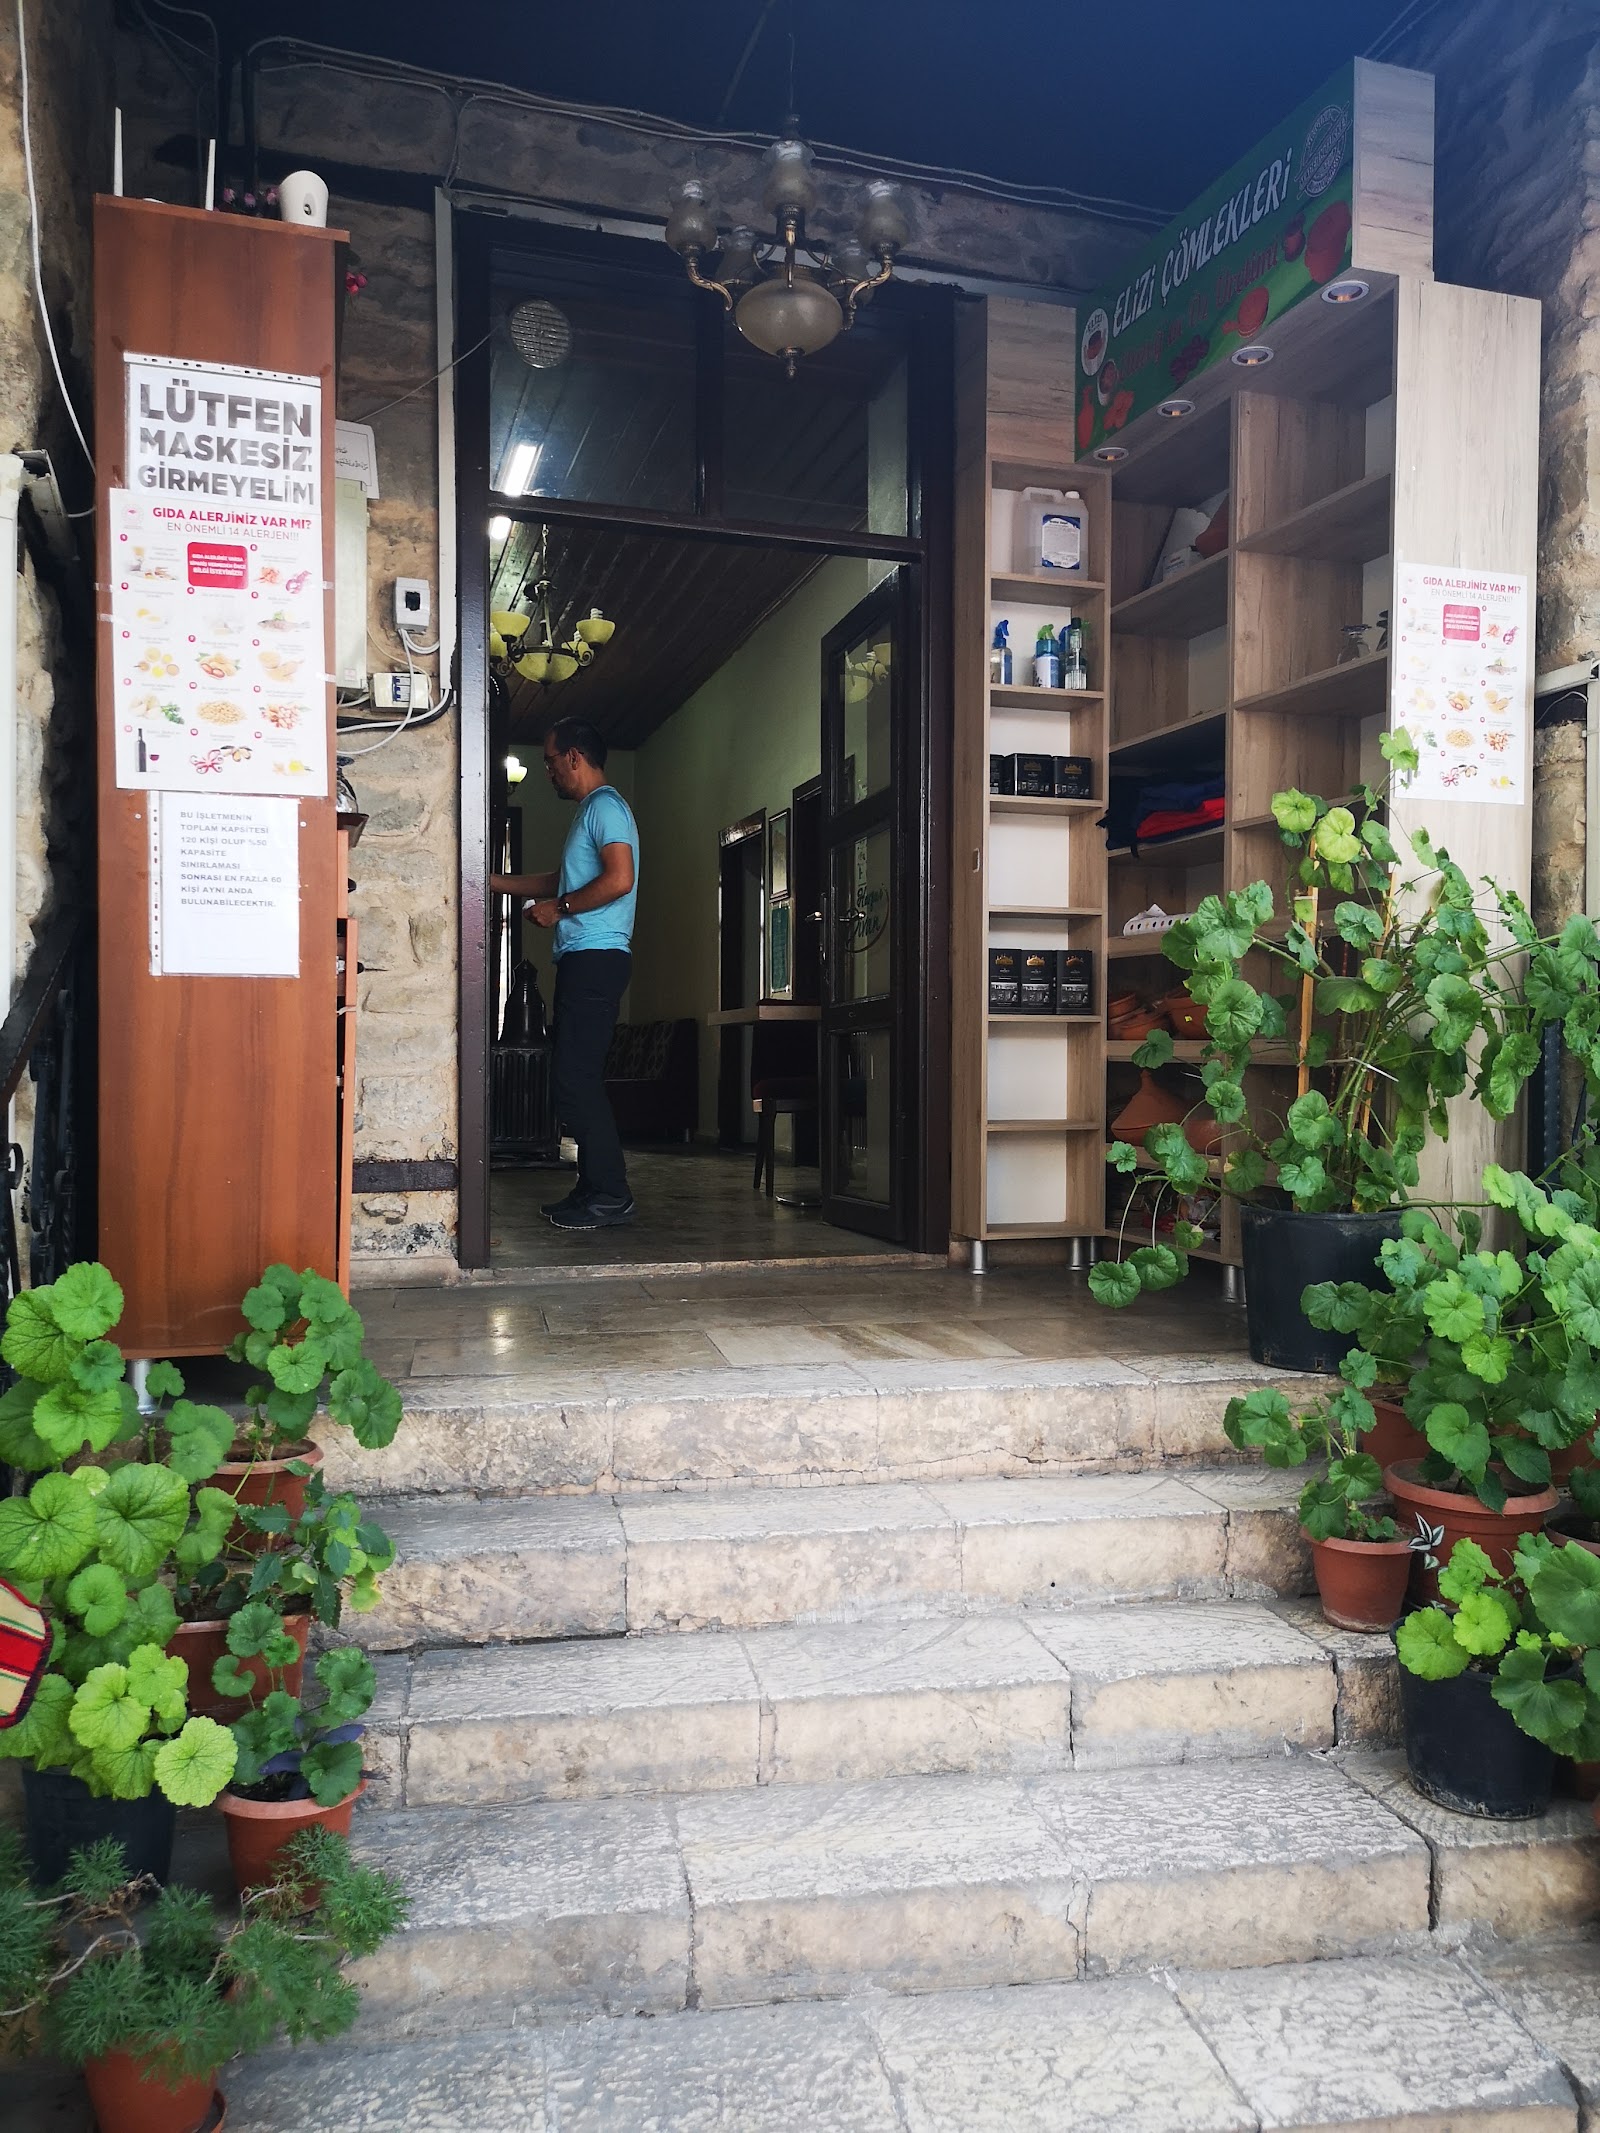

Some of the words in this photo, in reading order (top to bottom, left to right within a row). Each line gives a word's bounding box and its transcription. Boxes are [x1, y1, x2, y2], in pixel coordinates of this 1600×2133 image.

[1161, 147, 1293, 307] ÇÖMLEKLERİ
[139, 378, 312, 437] LÜTFEN
[139, 427, 313, 472] MASKESİZ
[137, 461, 314, 505] GİRMEYELİM
[152, 507, 185, 520] GIDA
[189, 510, 258, 525] ALERJİNİZ
[260, 515, 288, 528] VAR
[290, 518, 312, 529] MI?
[167, 522, 181, 531] EN
[185, 521, 226, 535] ÖNEMLİ
[228, 527, 240, 536] 14
[1422, 576, 1443, 587] GIDA
[1445, 579, 1488, 591] ALERJİNİZ
[1489, 583, 1506, 592] VAR
[1507, 585, 1522, 594] MI?
[1431, 588, 1440, 596] EN
[180, 811, 193, 819] BU
[180, 824, 218, 832] TOPLAM
[181, 836, 197, 844] 120
[199, 836, 218, 845] KİŞİ
[180, 849, 227, 857] KAPASİTE
[181, 873, 222, 881] SONRASI
[224, 874, 237, 882] EN
[239, 875, 268, 883] FAZLA
[181, 885, 200, 893] KİŞİ
